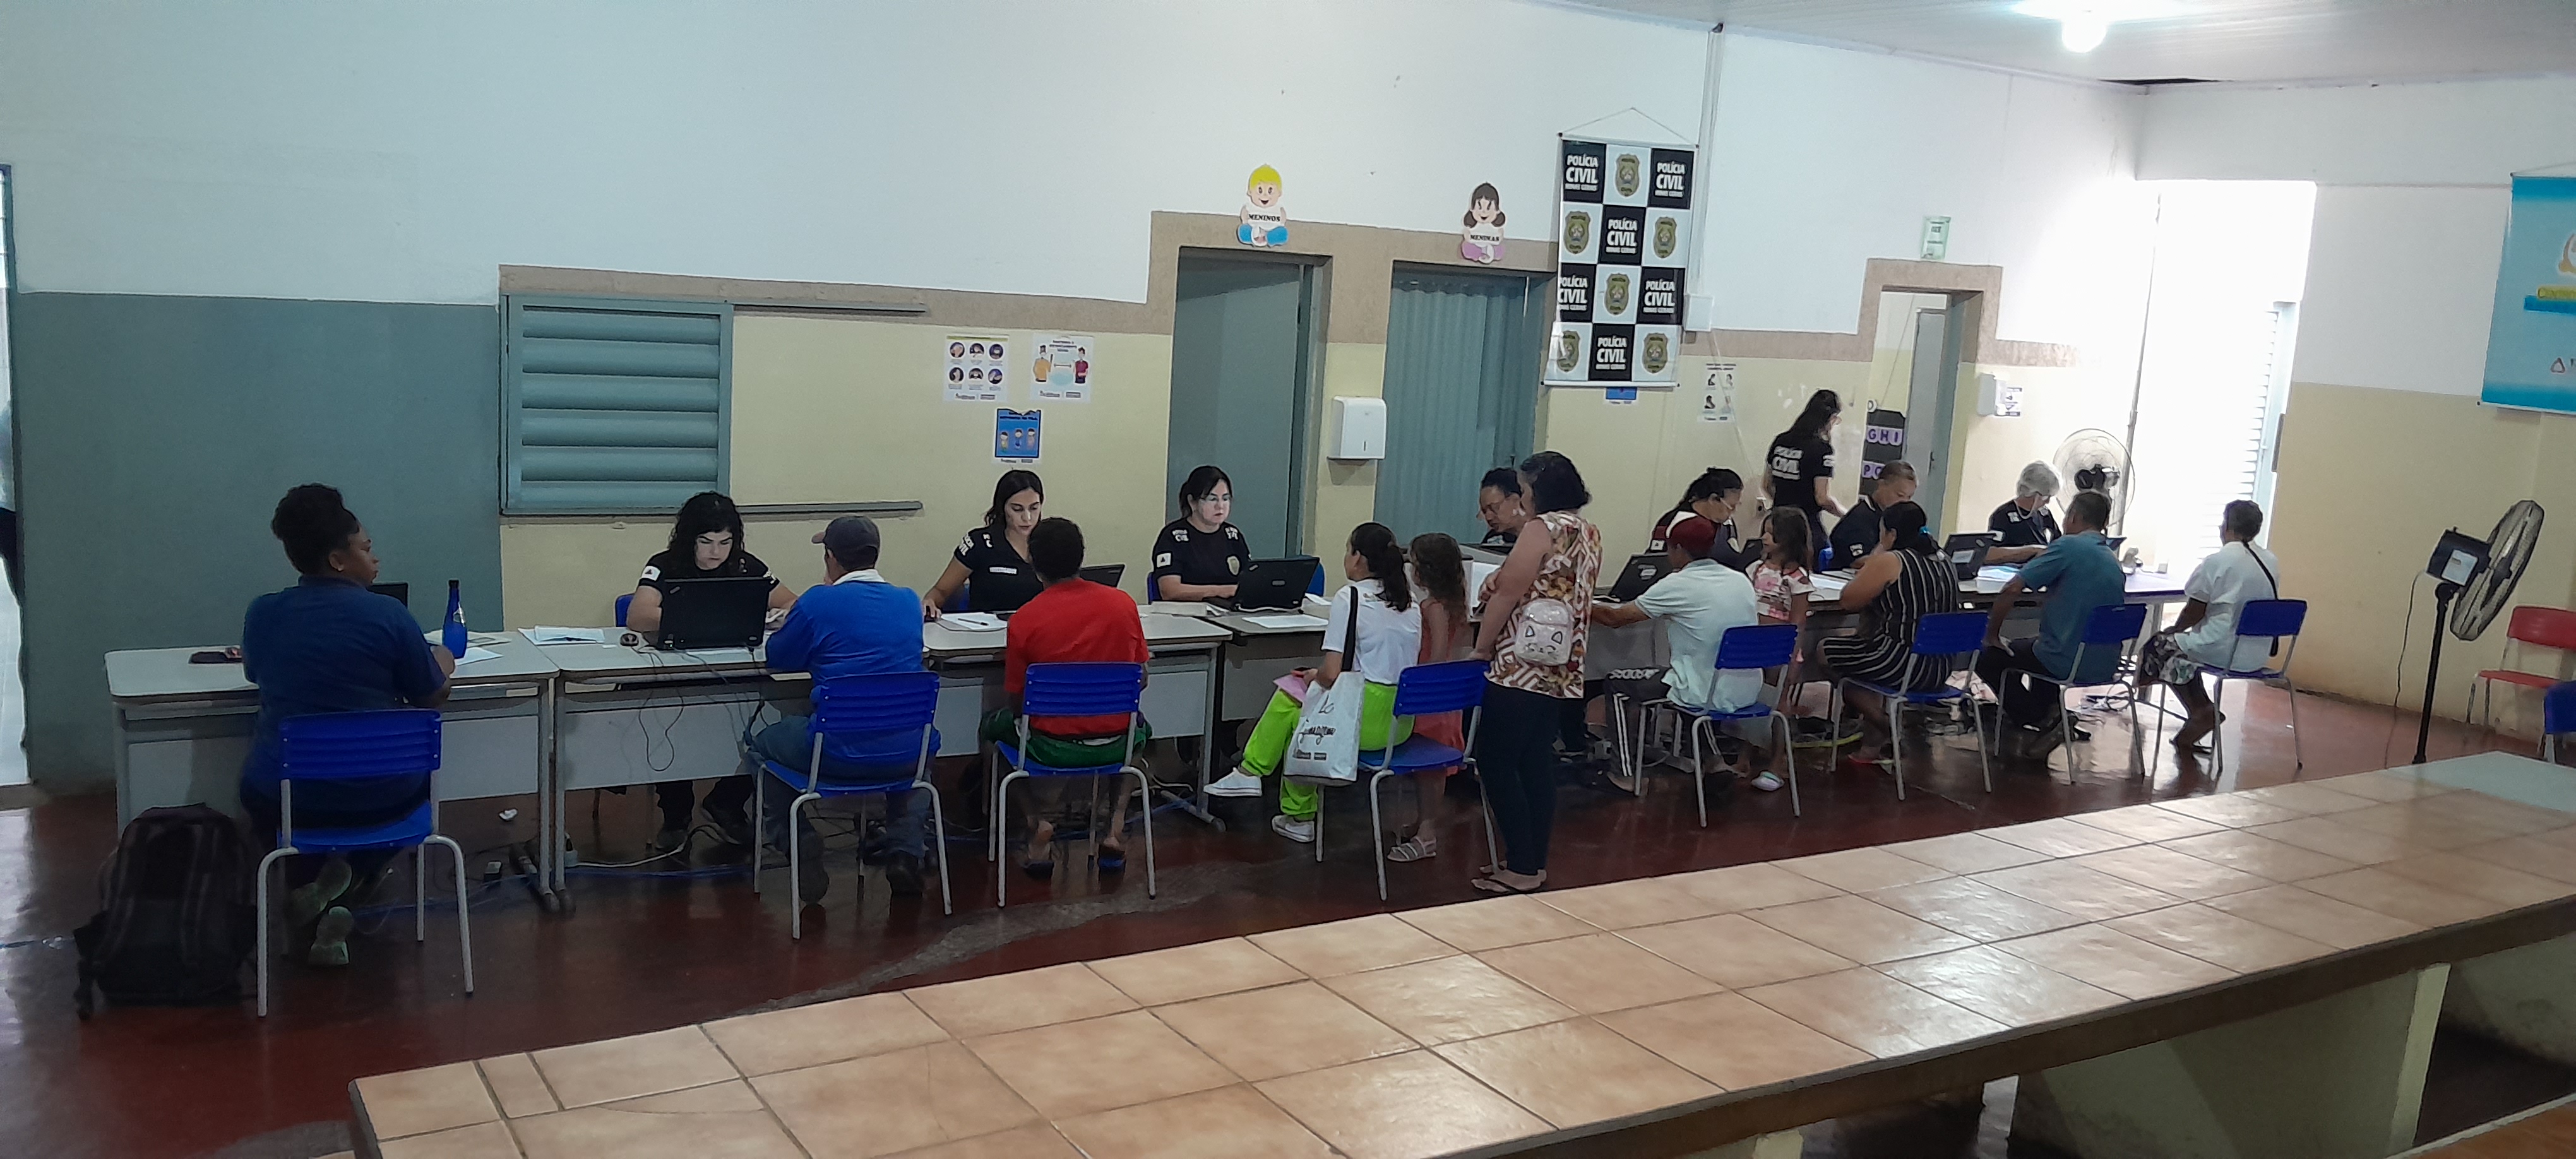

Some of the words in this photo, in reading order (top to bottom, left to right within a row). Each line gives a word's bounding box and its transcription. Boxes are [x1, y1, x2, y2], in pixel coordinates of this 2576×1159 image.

[1566, 153, 1599, 167] POLÍCIA
[1657, 161, 1685, 174] POLÍCIA
[1566, 167, 1599, 184] CIVIL
[1656, 174, 1685, 190] CIVIL
[1248, 214, 1280, 222] MENINOS
[1608, 217, 1638, 231] POLÍCIA
[1607, 230, 1637, 247] CIVIL
[1645, 278, 1676, 291] POLÍCIA
[1558, 288, 1588, 304] CIVIL
[1644, 292, 1676, 306] CIVIL
[1597, 335, 1627, 347] POLÍCIA
[1597, 348, 1627, 363] CIVIL
